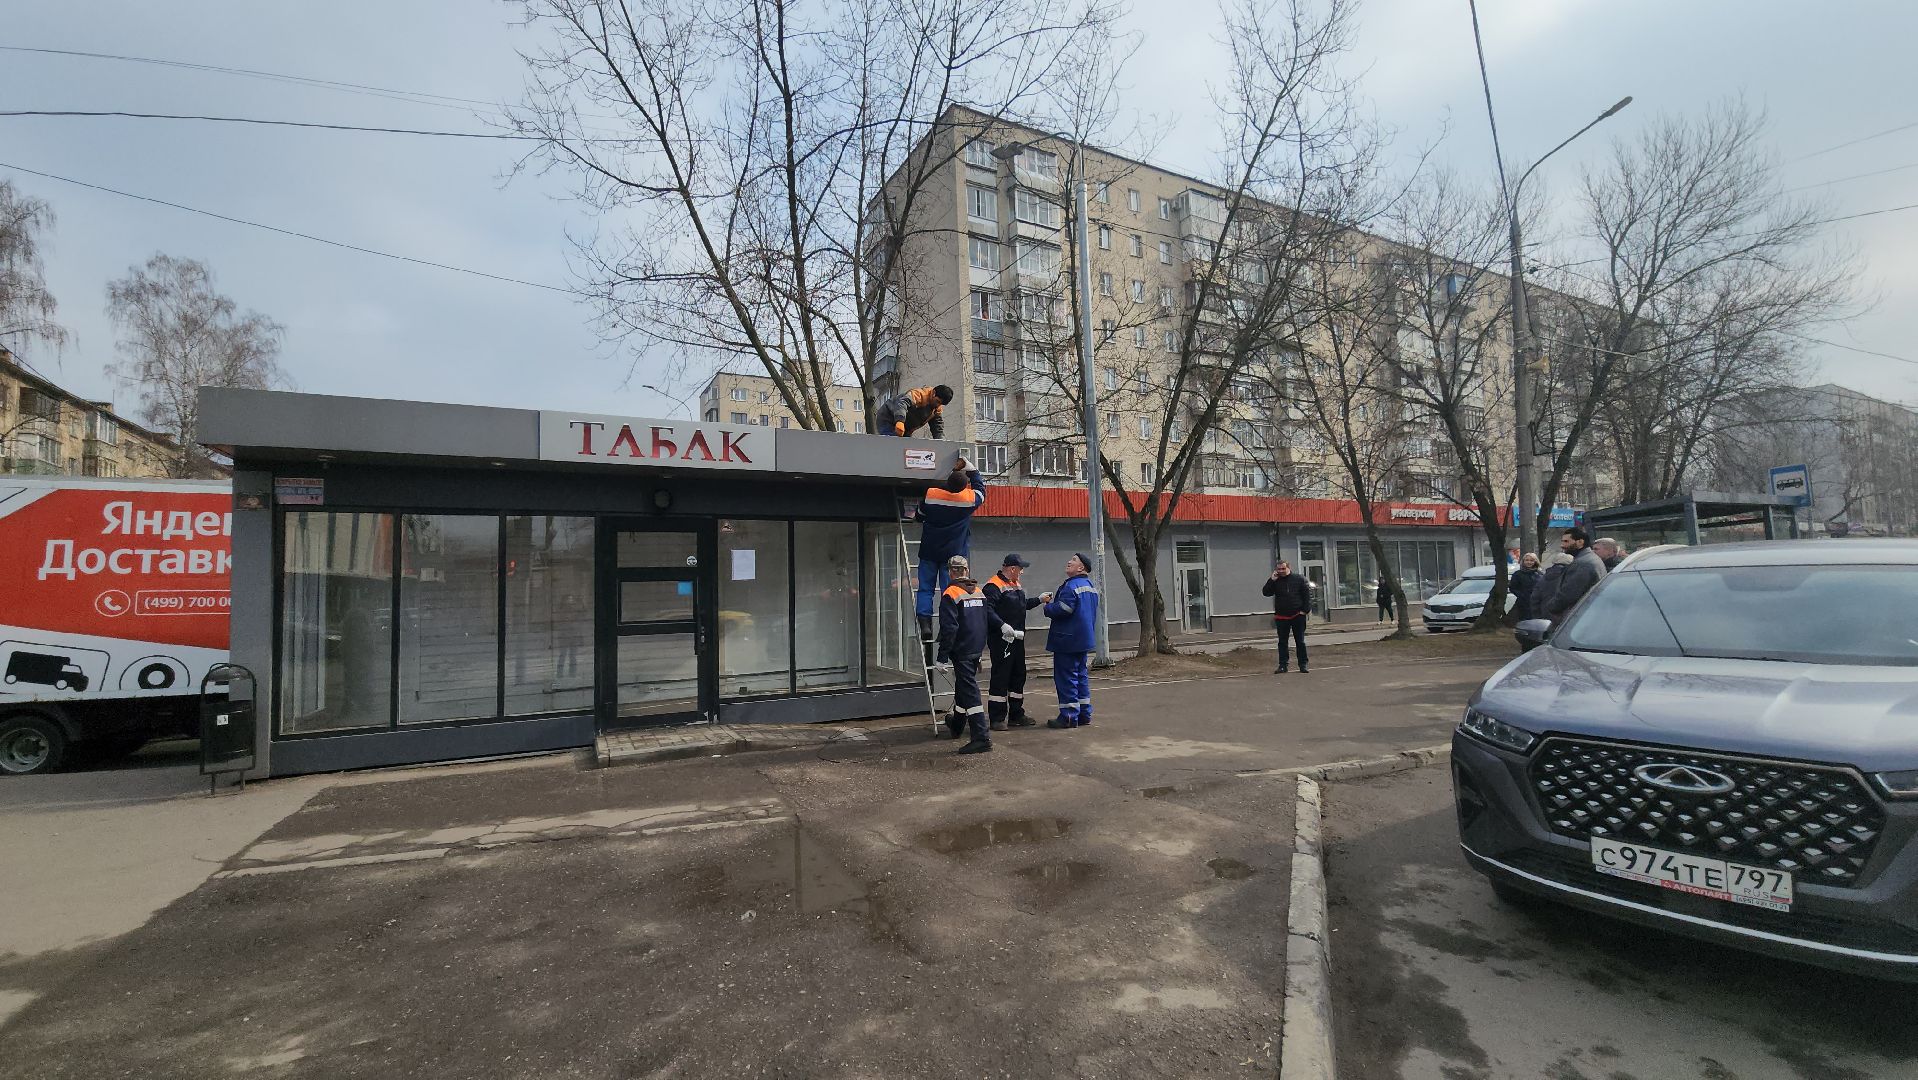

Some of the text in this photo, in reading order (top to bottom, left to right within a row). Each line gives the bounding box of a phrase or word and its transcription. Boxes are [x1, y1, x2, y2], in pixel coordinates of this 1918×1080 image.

[570, 420, 752, 463] ТАБАК
[144, 596, 184, 609] (499)
[189, 596, 216, 608] 700
[1730, 866, 1783, 893] 797
